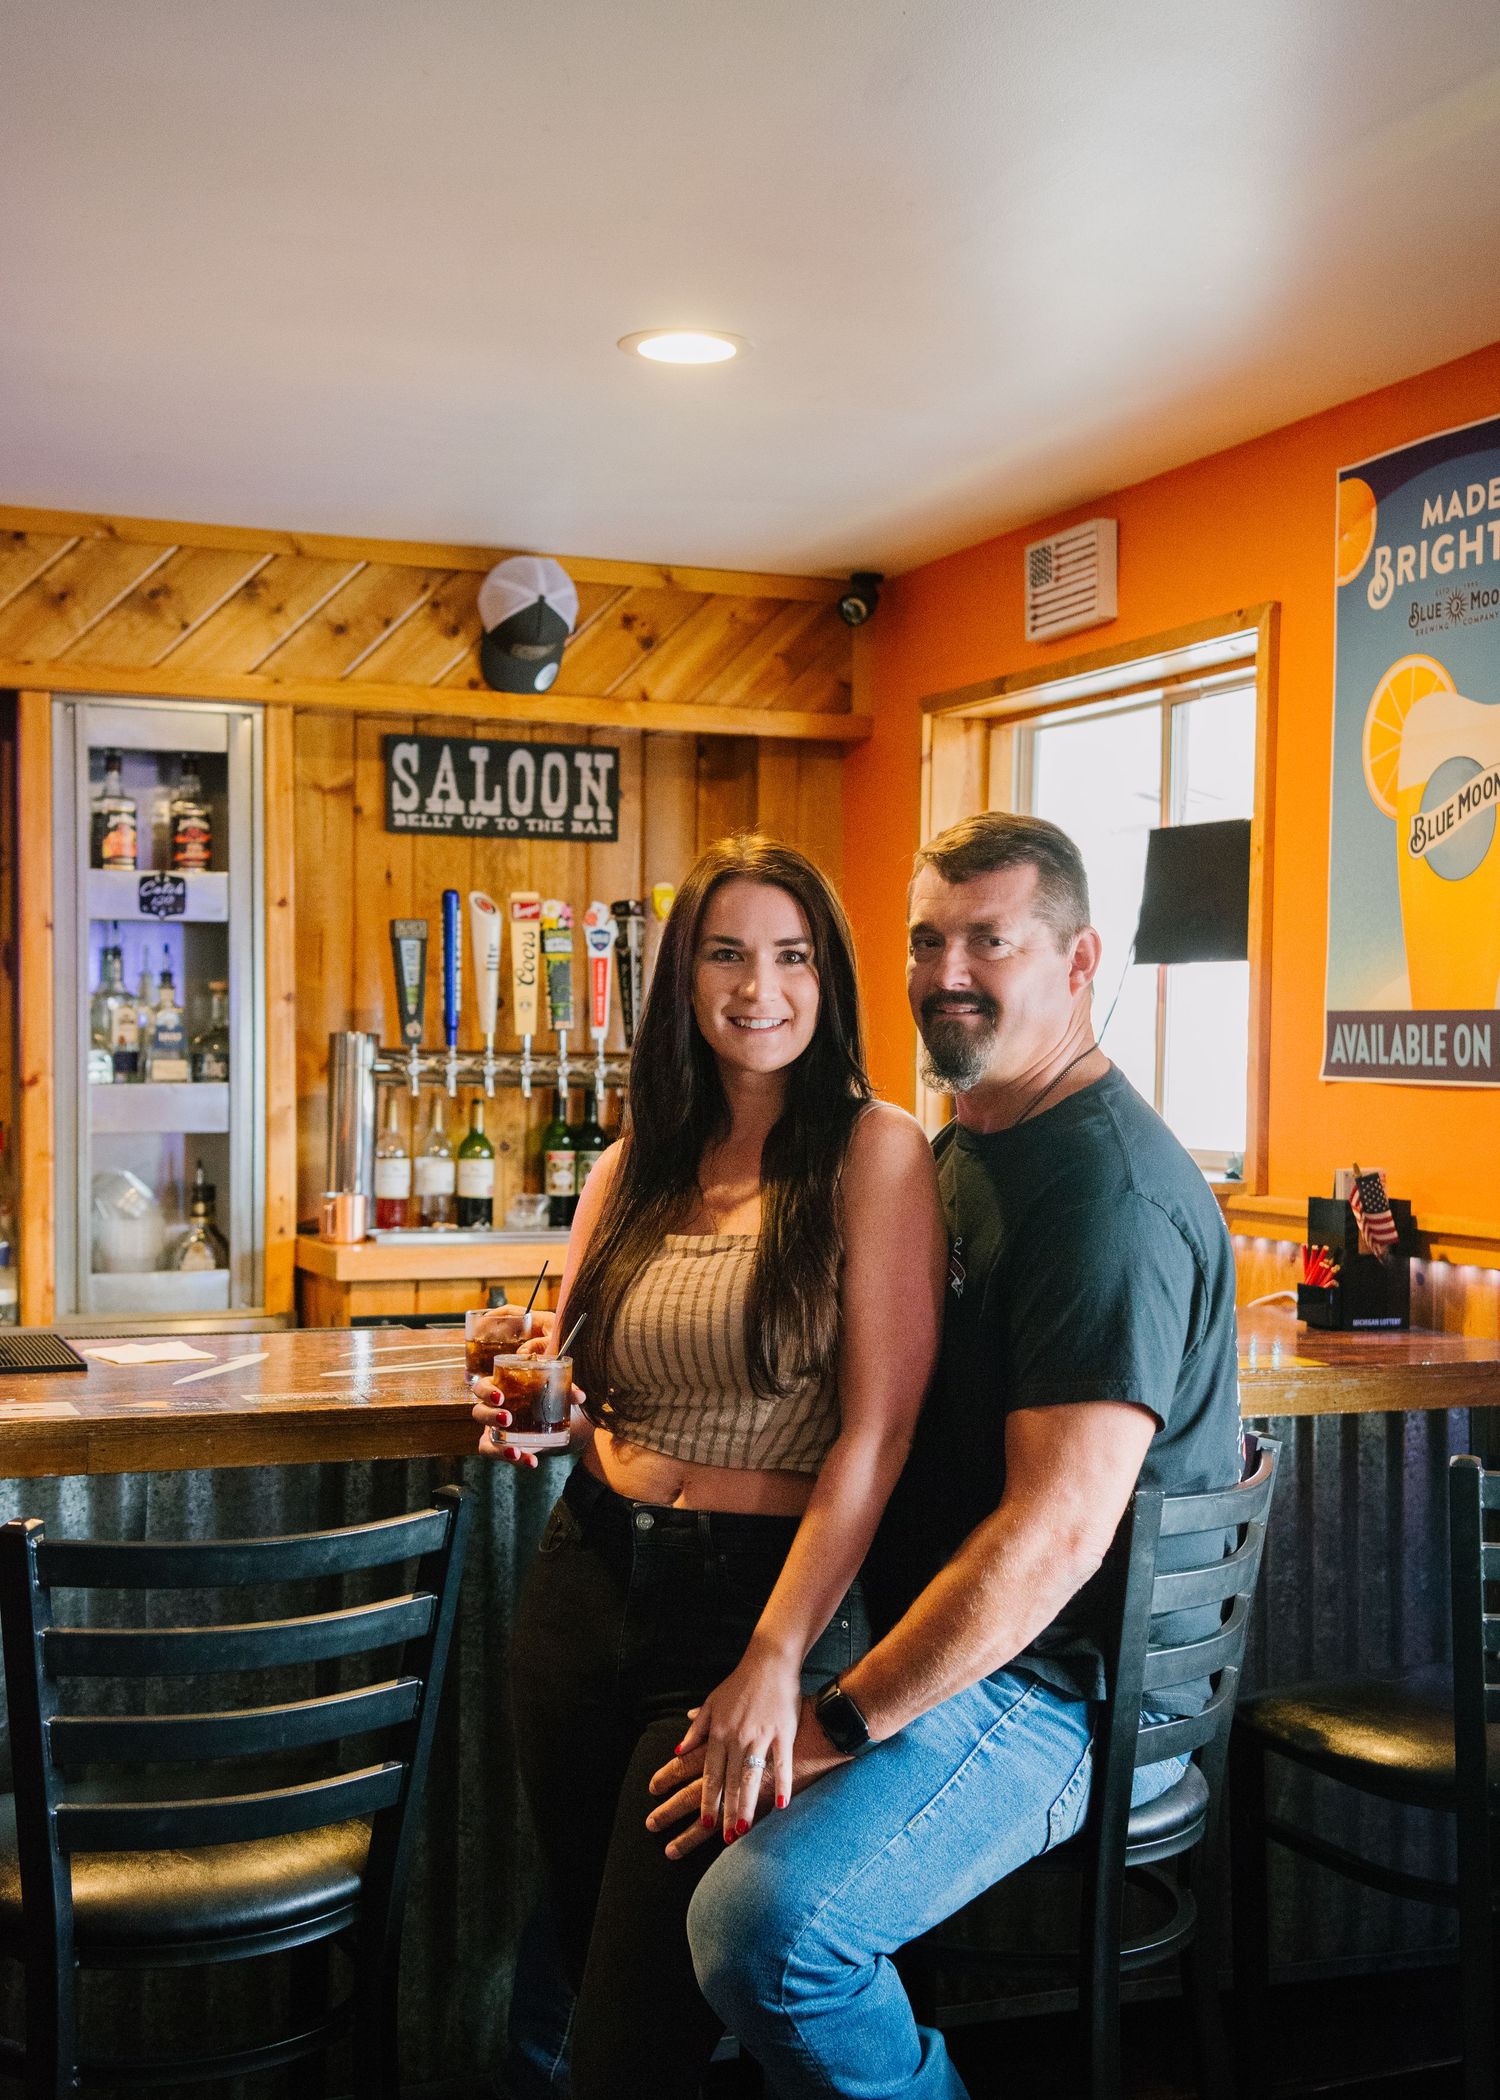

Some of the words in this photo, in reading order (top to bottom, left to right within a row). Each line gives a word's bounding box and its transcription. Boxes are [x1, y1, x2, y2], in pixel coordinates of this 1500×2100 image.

[1421, 476, 1500, 530] MADE
[1408, 601, 1442, 629] BLUE
[392, 742, 614, 821] SALOON
[393, 812, 455, 829] BELLY
[462, 815, 488, 830] UP
[494, 817, 520, 832] TO
[525, 818, 564, 833] THE
[571, 820, 612, 835] BAR
[1410, 803, 1454, 854] BLUE
[516, 931, 536, 986] Coors
[1330, 1023, 1448, 1066] AVAILABLE
[1453, 1023, 1491, 1068] ON
